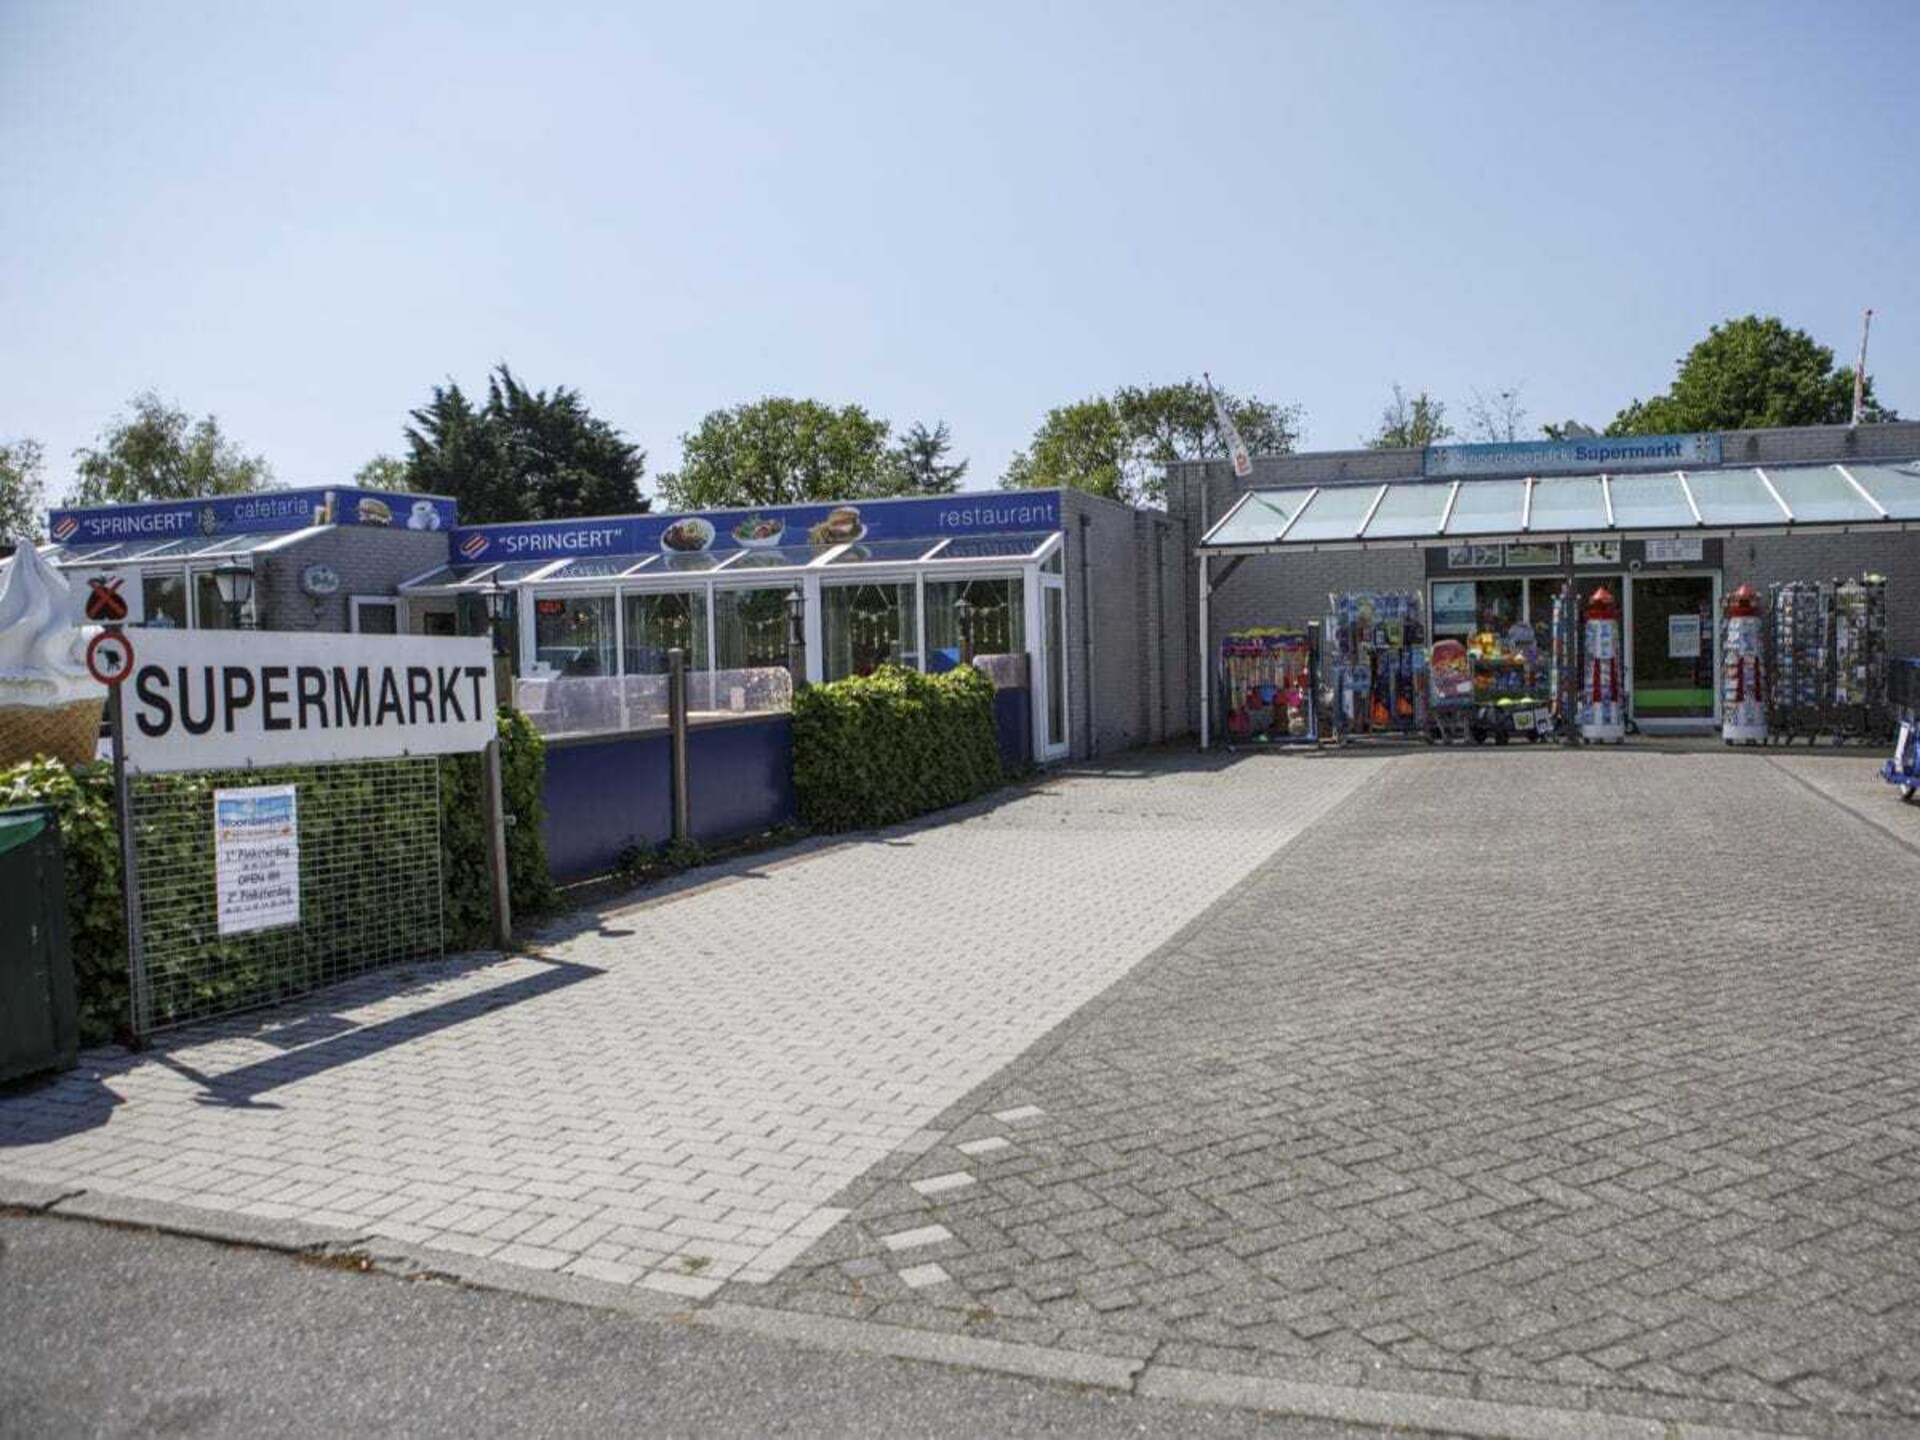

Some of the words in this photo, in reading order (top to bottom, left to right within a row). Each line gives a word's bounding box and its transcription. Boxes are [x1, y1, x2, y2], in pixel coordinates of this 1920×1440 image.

[1576, 442, 1682, 462] Supermarkt
[234, 497, 308, 519] cafetaria
[939, 503, 1054, 527] restaurant
[84, 511, 192, 536] "SPRINGERT"
[498, 528, 622, 553] "SPRINGERT"
[135, 664, 488, 738] SUPERMARKT
